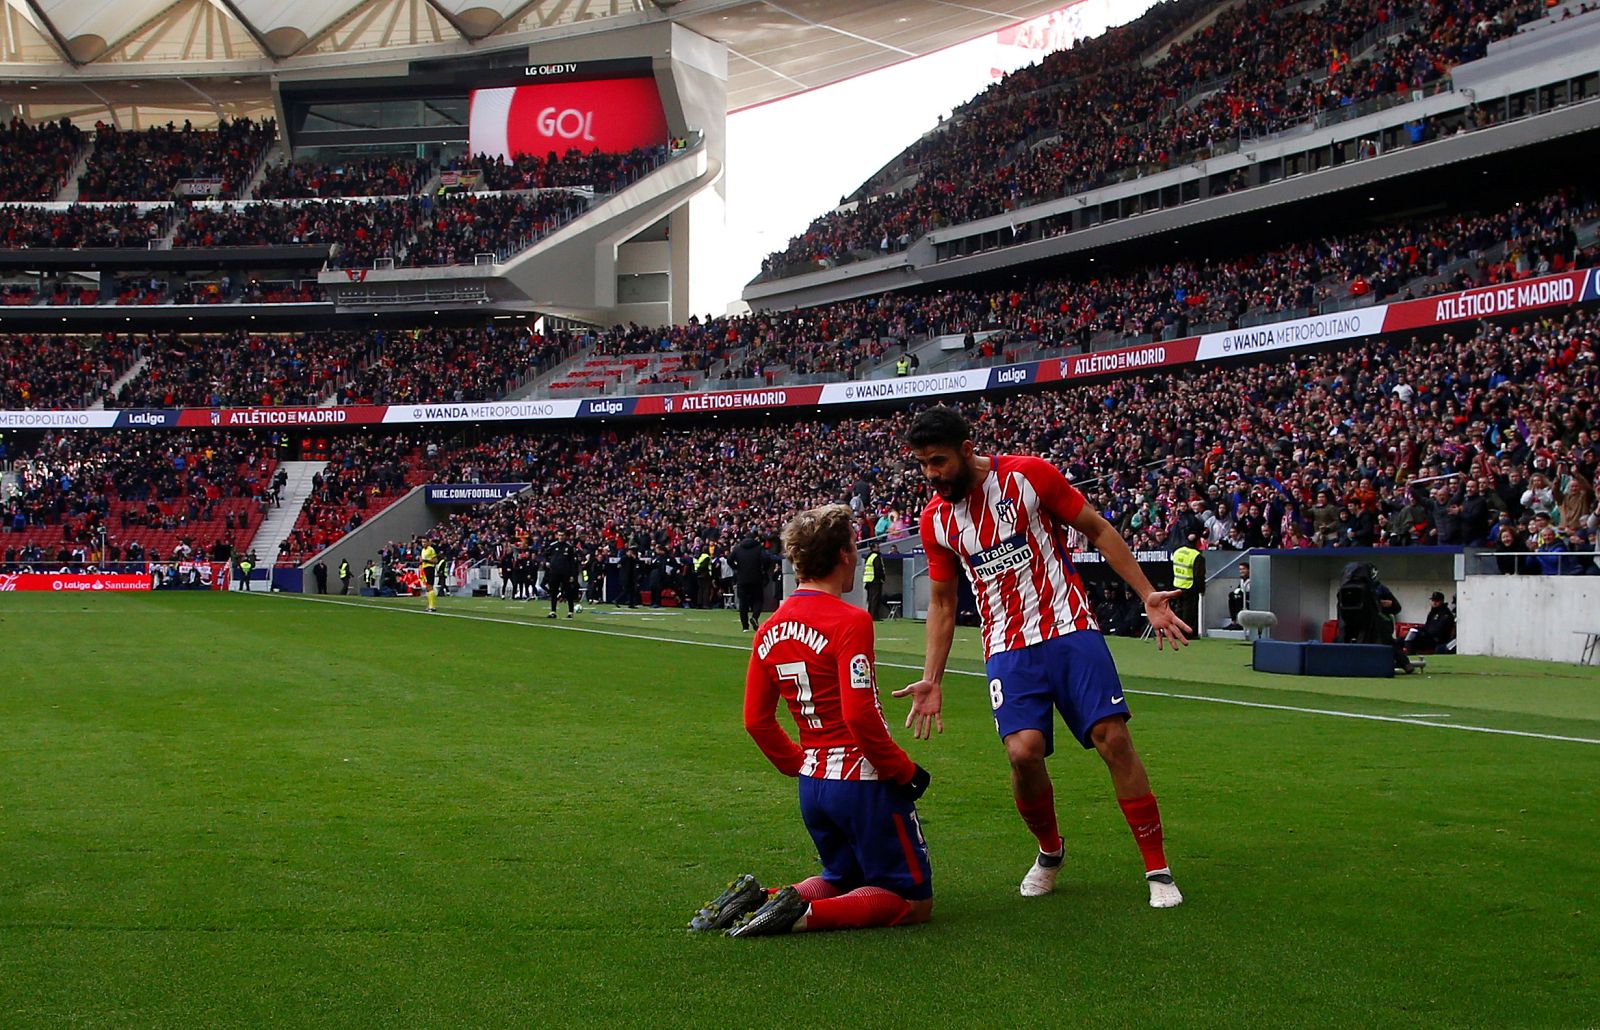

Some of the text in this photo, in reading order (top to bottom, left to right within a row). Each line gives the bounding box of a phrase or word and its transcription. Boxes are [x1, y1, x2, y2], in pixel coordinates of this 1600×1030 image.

[525, 63, 577, 76] LG OLED TV
[537, 106, 595, 141] GOL
[1435, 290, 1495, 321] ATLÉTICO
[1497, 287, 1516, 312] DE
[1517, 277, 1574, 308] MADRID
[1233, 315, 1361, 351] WANDA METROPOLITANO
[1074, 353, 1118, 375] ATLÉTICO
[1126, 347, 1166, 367] MADRID
[997, 367, 1027, 384] LaLiga
[856, 375, 968, 399] WANDA METROPOLITANO
[589, 400, 624, 414] LaLiga
[681, 393, 733, 411] ATLÉTICO
[743, 391, 787, 407] MADRID
[0, 414, 89, 425] METROPOLITANO
[129, 412, 166, 425] LaLiga
[230, 409, 287, 425] ATLÉTICO
[298, 410, 346, 423] MADRID
[425, 404, 554, 419] WANDA METROPOLITANO
[431, 488, 503, 499] NIKE.COM/FOOTBALL
[978, 541, 1015, 563] Trade
[975, 548, 1032, 579] Plus500
[64, 580, 91, 590] LaLiga
[105, 579, 150, 590] Santander
[757, 621, 829, 660] GRIEZMANN
[775, 661, 823, 729] 7
[989, 678, 1004, 710] 8
